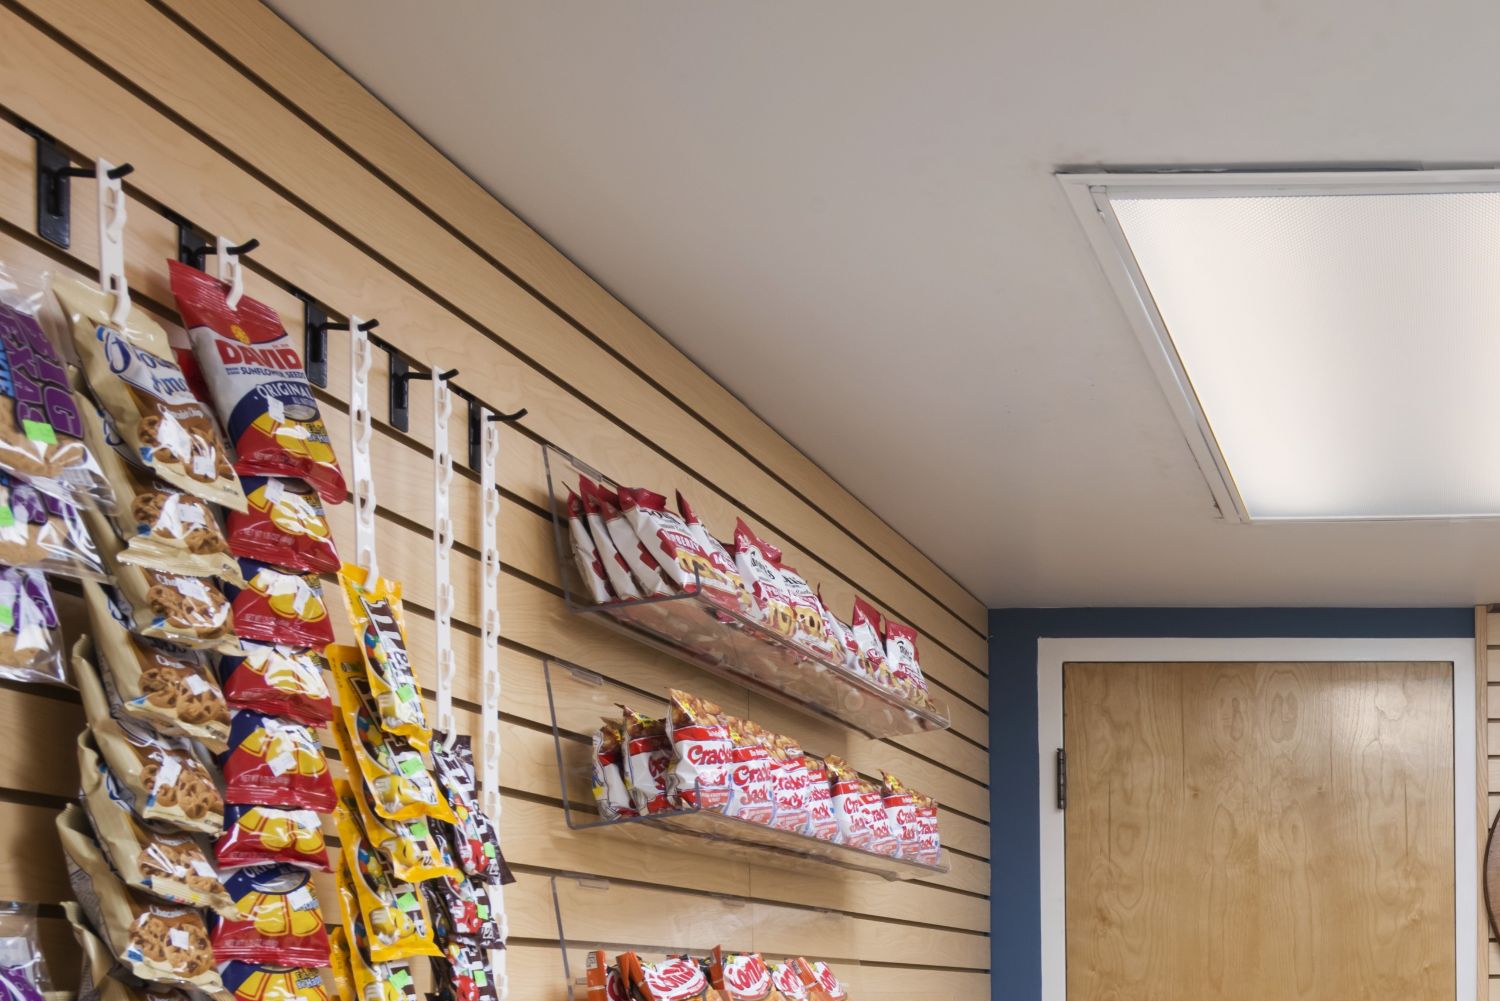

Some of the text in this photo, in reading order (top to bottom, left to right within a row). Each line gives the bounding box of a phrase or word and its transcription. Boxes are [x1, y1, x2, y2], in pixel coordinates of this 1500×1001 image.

[215, 339, 303, 370] DAVID
[240, 366, 284, 379] SUNFLOWER
[256, 382, 315, 400] ORIGINAL
